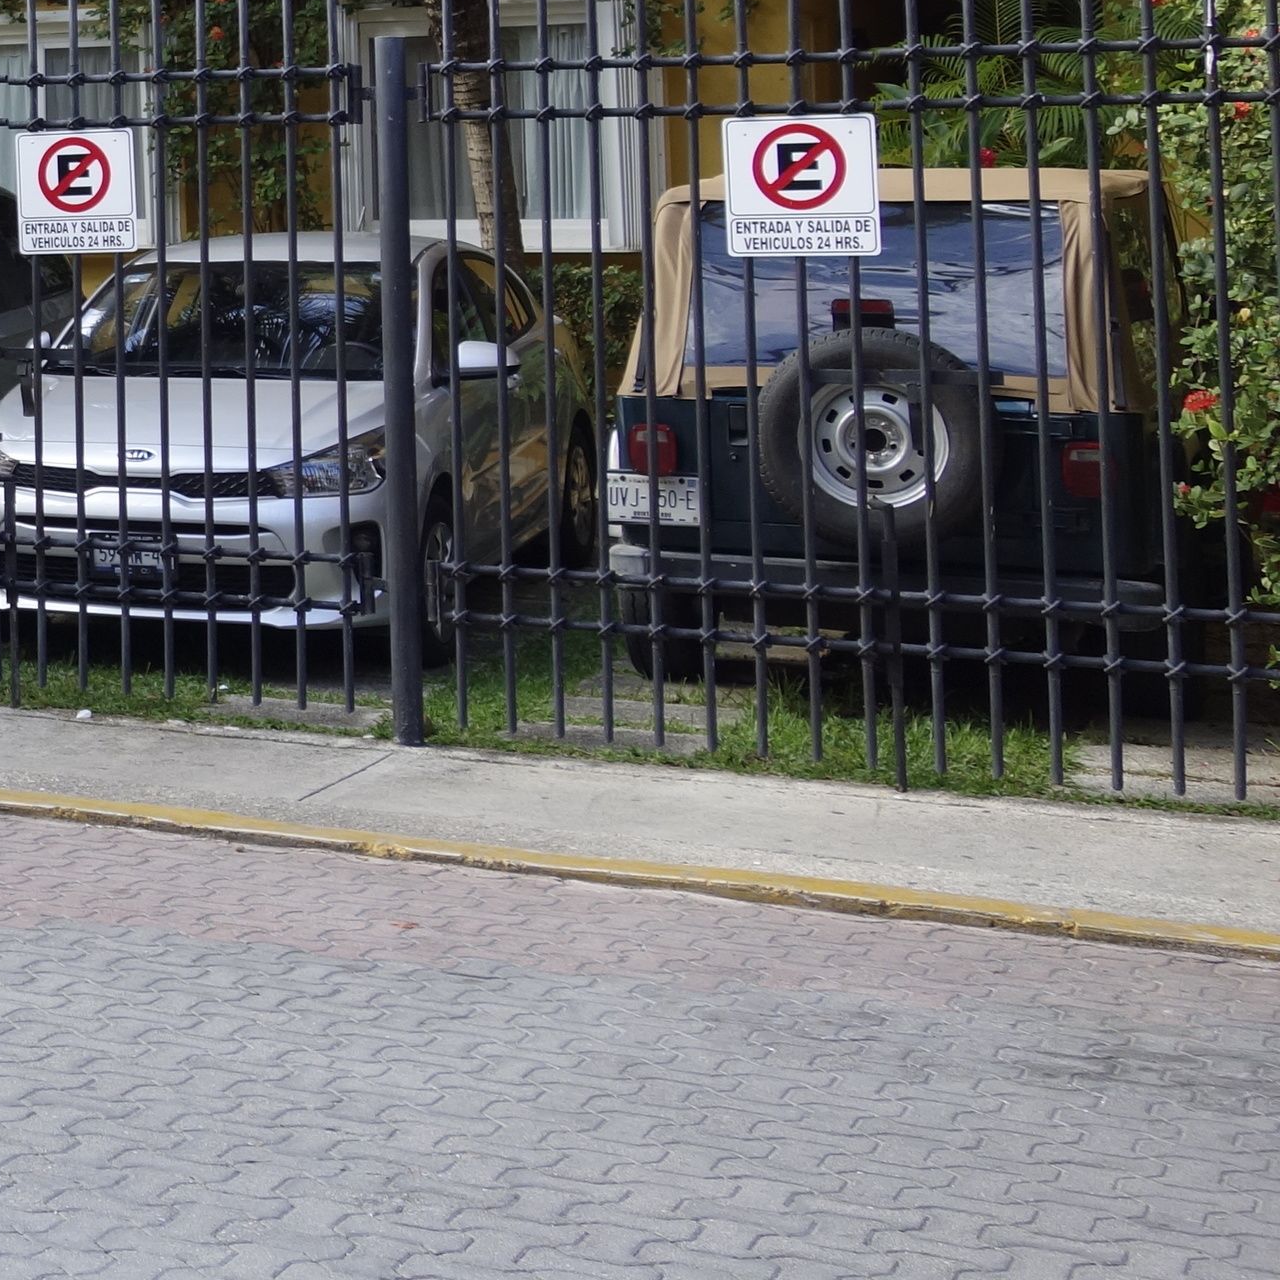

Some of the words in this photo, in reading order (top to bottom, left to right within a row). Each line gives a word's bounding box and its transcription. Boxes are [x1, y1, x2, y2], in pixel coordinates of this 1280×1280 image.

[25, 222, 69, 235] ENTRADA
[72, 222, 78, 233] Y
[81, 221, 115, 233] SALIDA
[118, 220, 131, 232] DE
[736, 221, 792, 234] ENTRADA
[796, 221, 803, 233] Y
[807, 220, 851, 233] SALIDA
[855, 219, 872, 233] DE
[31, 236, 86, 248] VEHICULOS
[88, 236, 99, 247] 24
[102, 235, 125, 246] HRS.
[744, 237, 814, 250] VEHICULOS
[817, 236, 831, 249] 24
[835, 236, 865, 249] HRS.
[609, 486, 696, 511] UVJ-50-E
